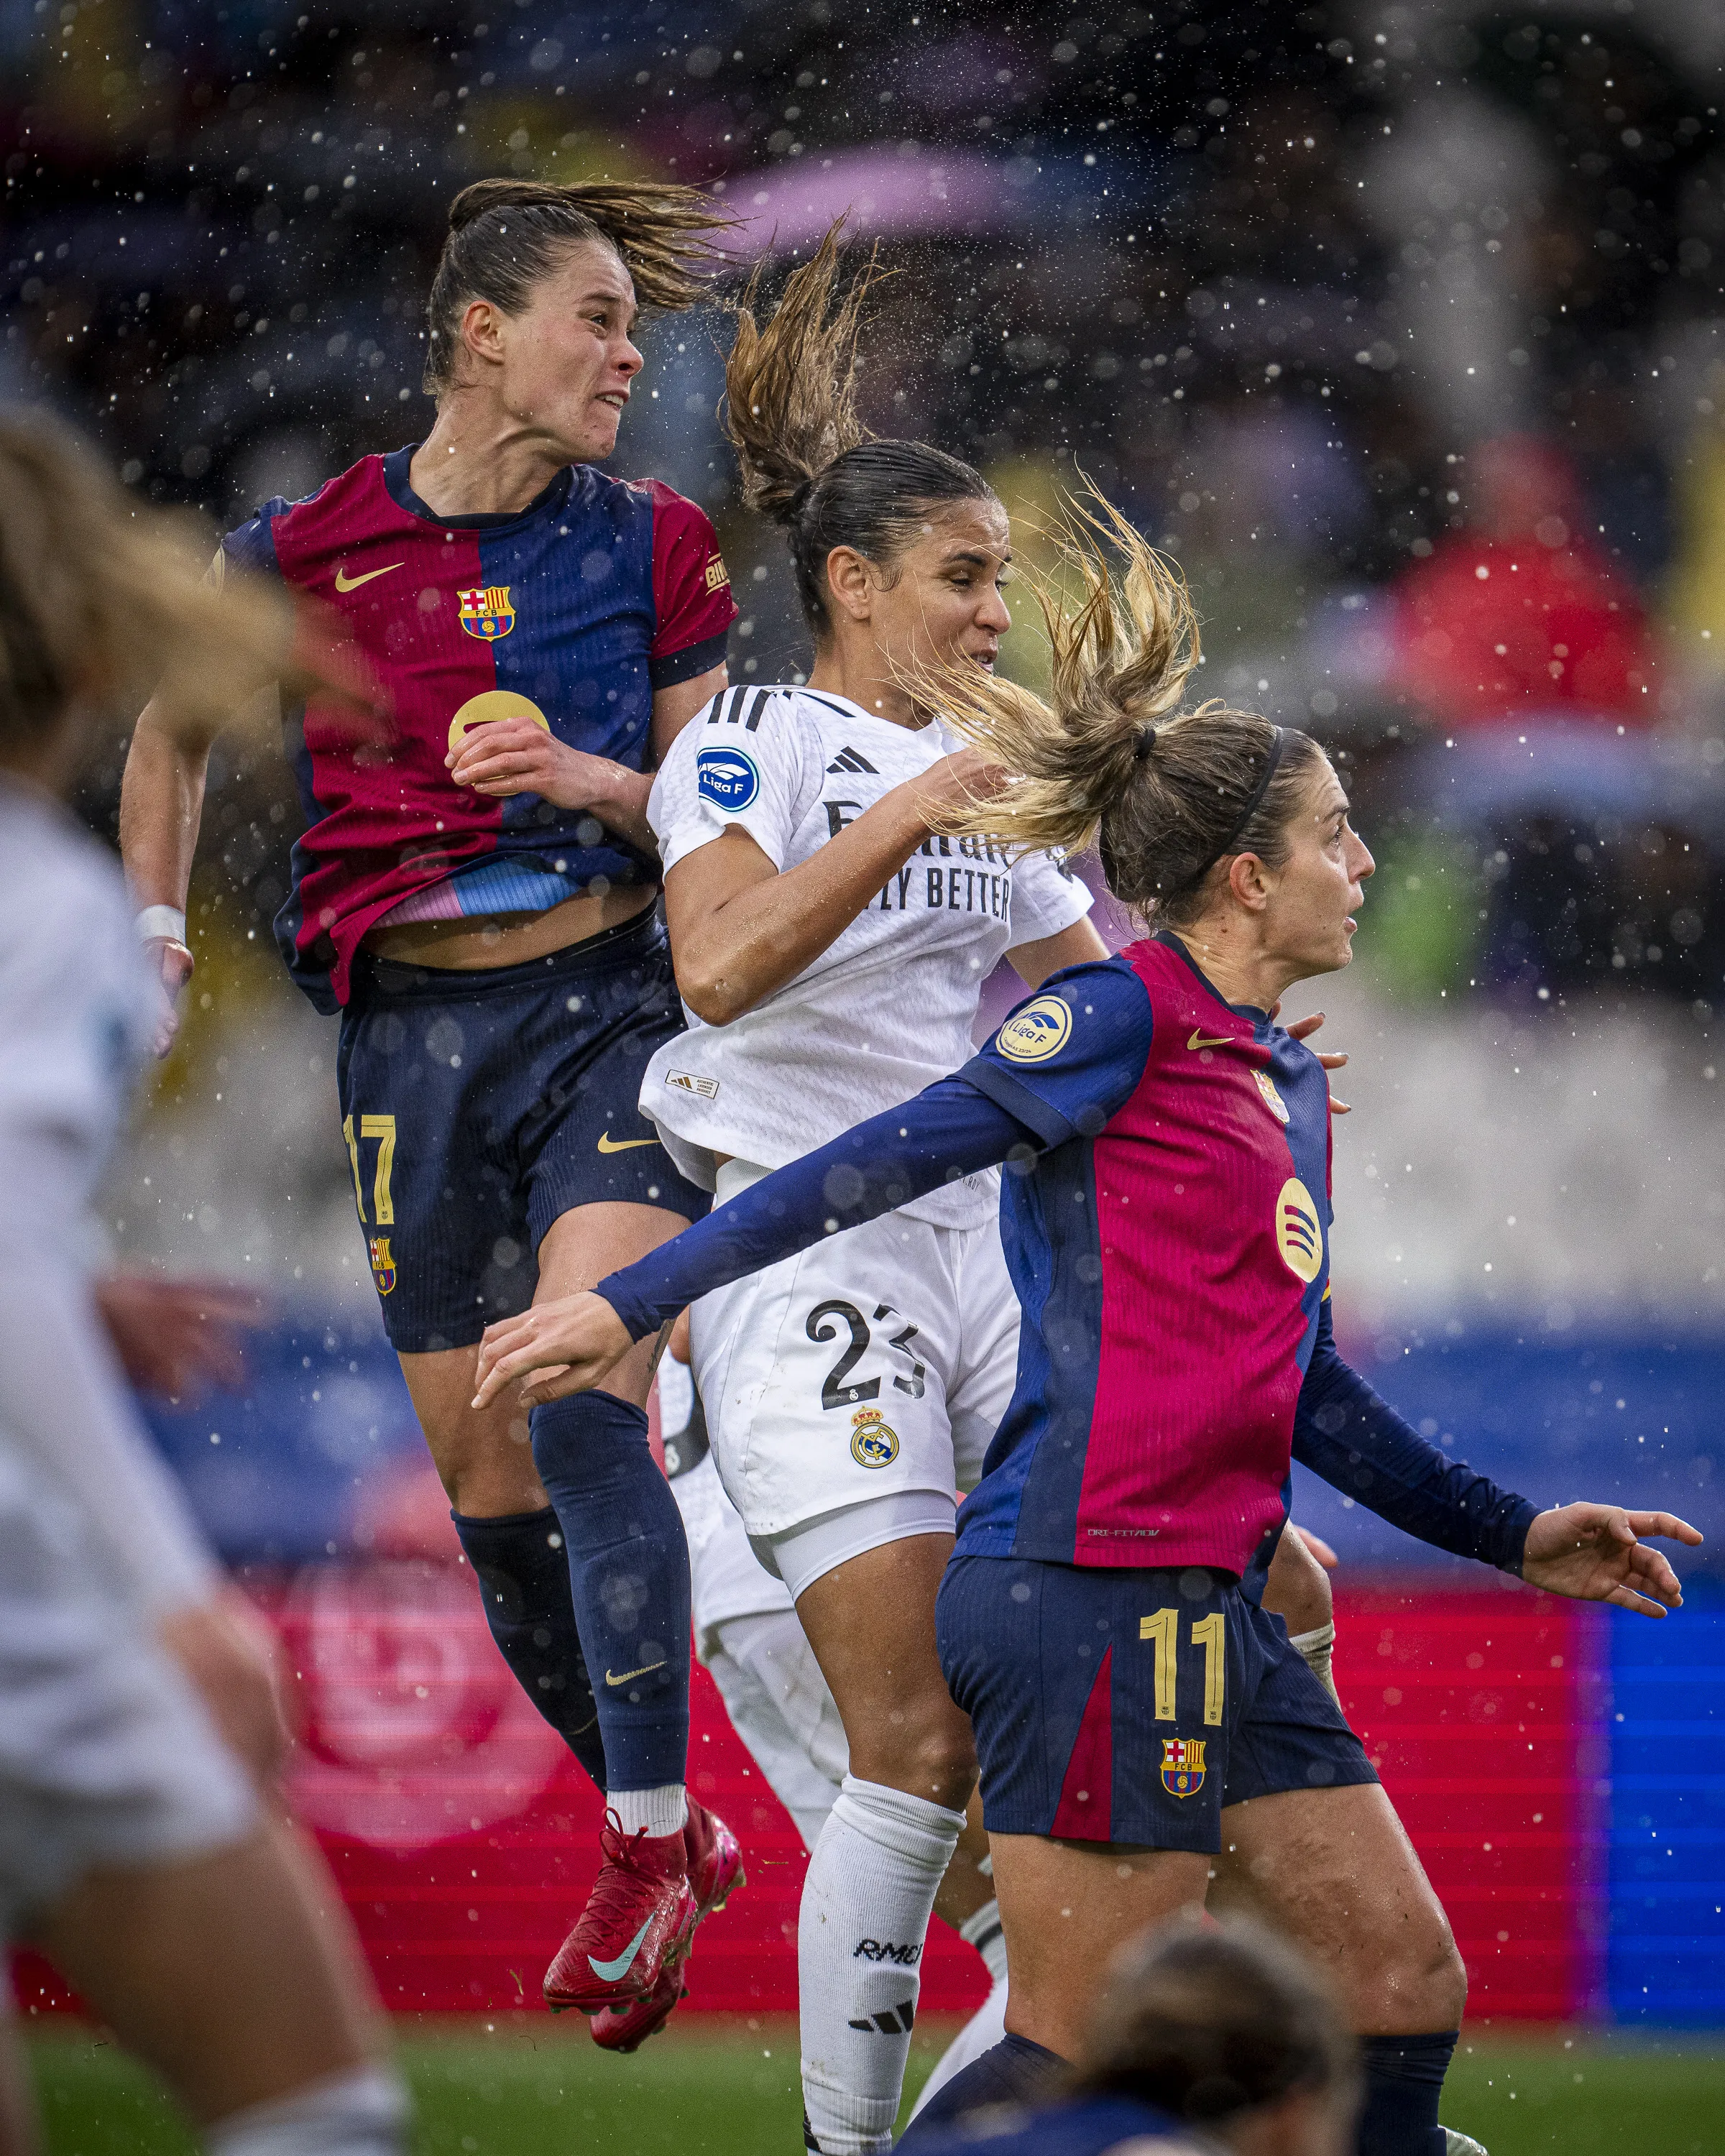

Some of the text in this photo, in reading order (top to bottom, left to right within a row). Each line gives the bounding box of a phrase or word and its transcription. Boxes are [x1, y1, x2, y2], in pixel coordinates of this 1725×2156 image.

[703, 773, 744, 794] Liga F
[863, 867, 1010, 923] LY BETTER
[1012, 1022, 1047, 1044] Liga F
[343, 1114, 397, 1225] 17
[805, 1299, 926, 1411] 23
[1139, 1608, 1225, 1726] 11
[1174, 1762, 1193, 1772] FCB
